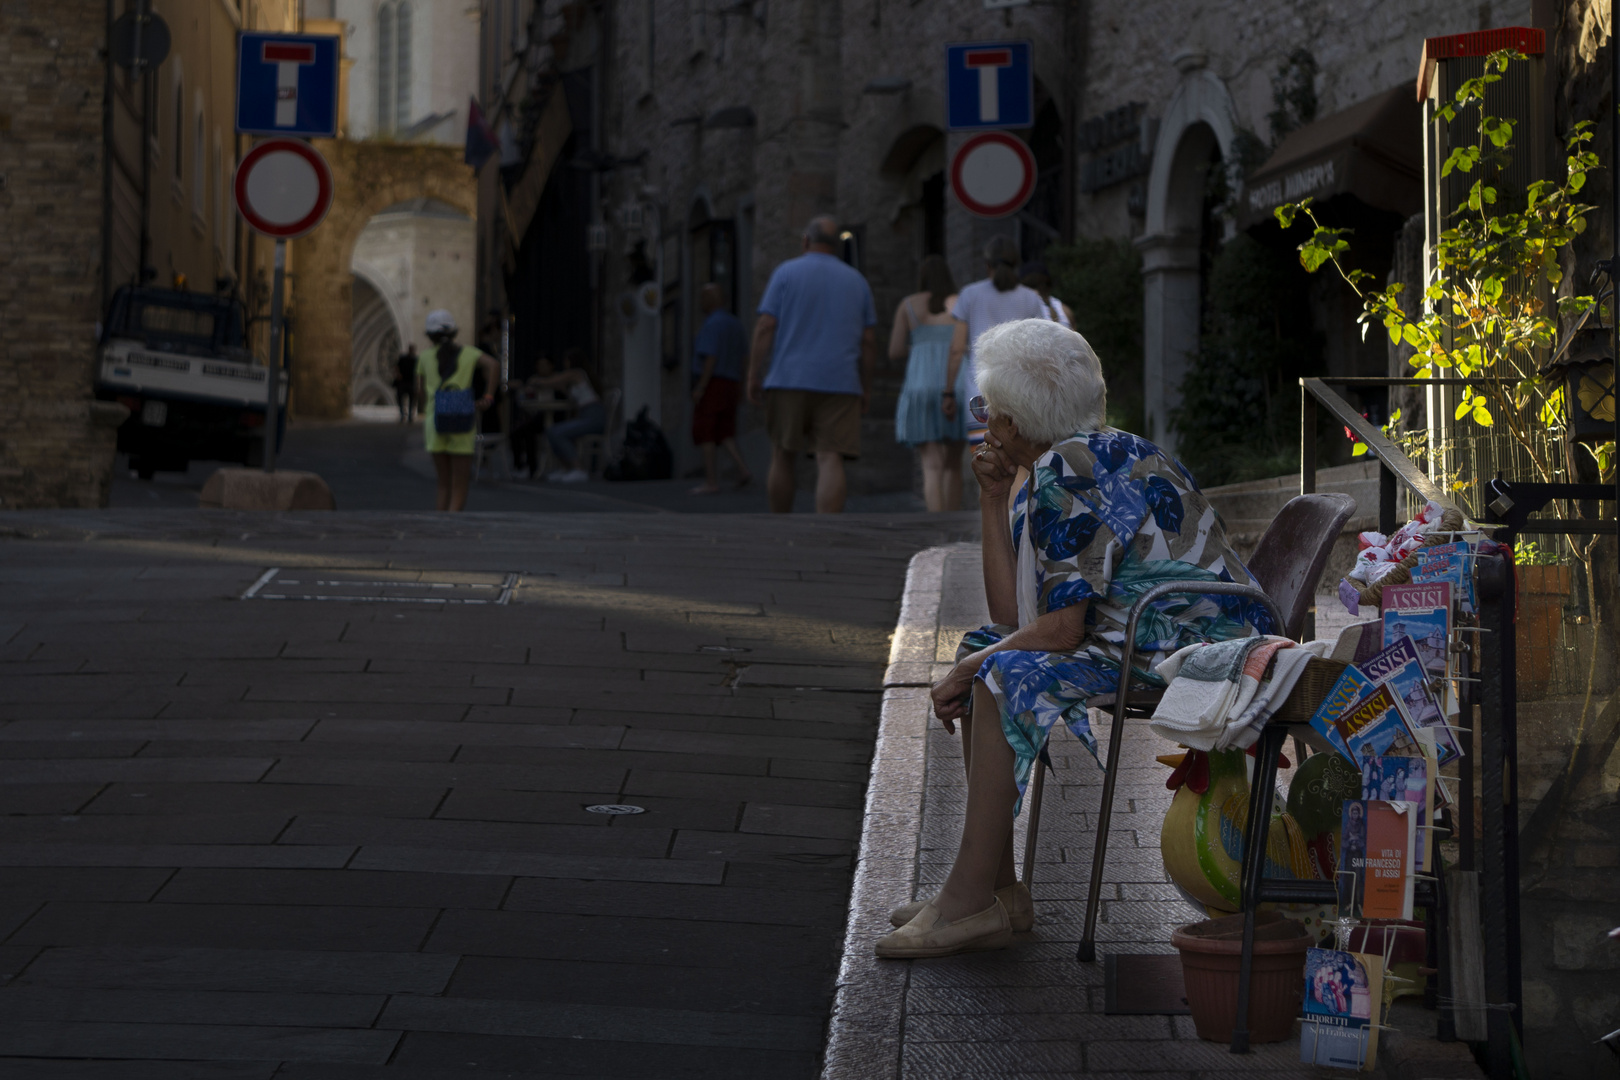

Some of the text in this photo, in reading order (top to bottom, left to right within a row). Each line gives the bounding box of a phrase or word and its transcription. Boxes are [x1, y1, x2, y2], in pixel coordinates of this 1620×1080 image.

[1428, 544, 1457, 556] ASSISI
[1421, 559, 1450, 575] ASSISI
[1390, 590, 1443, 610] ASSISI
[1368, 645, 1410, 684] SSISI
[1321, 675, 1363, 732] ASSISI
[1346, 694, 1389, 738] ASSISI
[1381, 849, 1401, 858] VITA DI
[1352, 858, 1401, 869] SAN FRANCESCO
[1375, 869, 1401, 879] DI ASSISI
[1309, 1025, 1324, 1035] Sn
